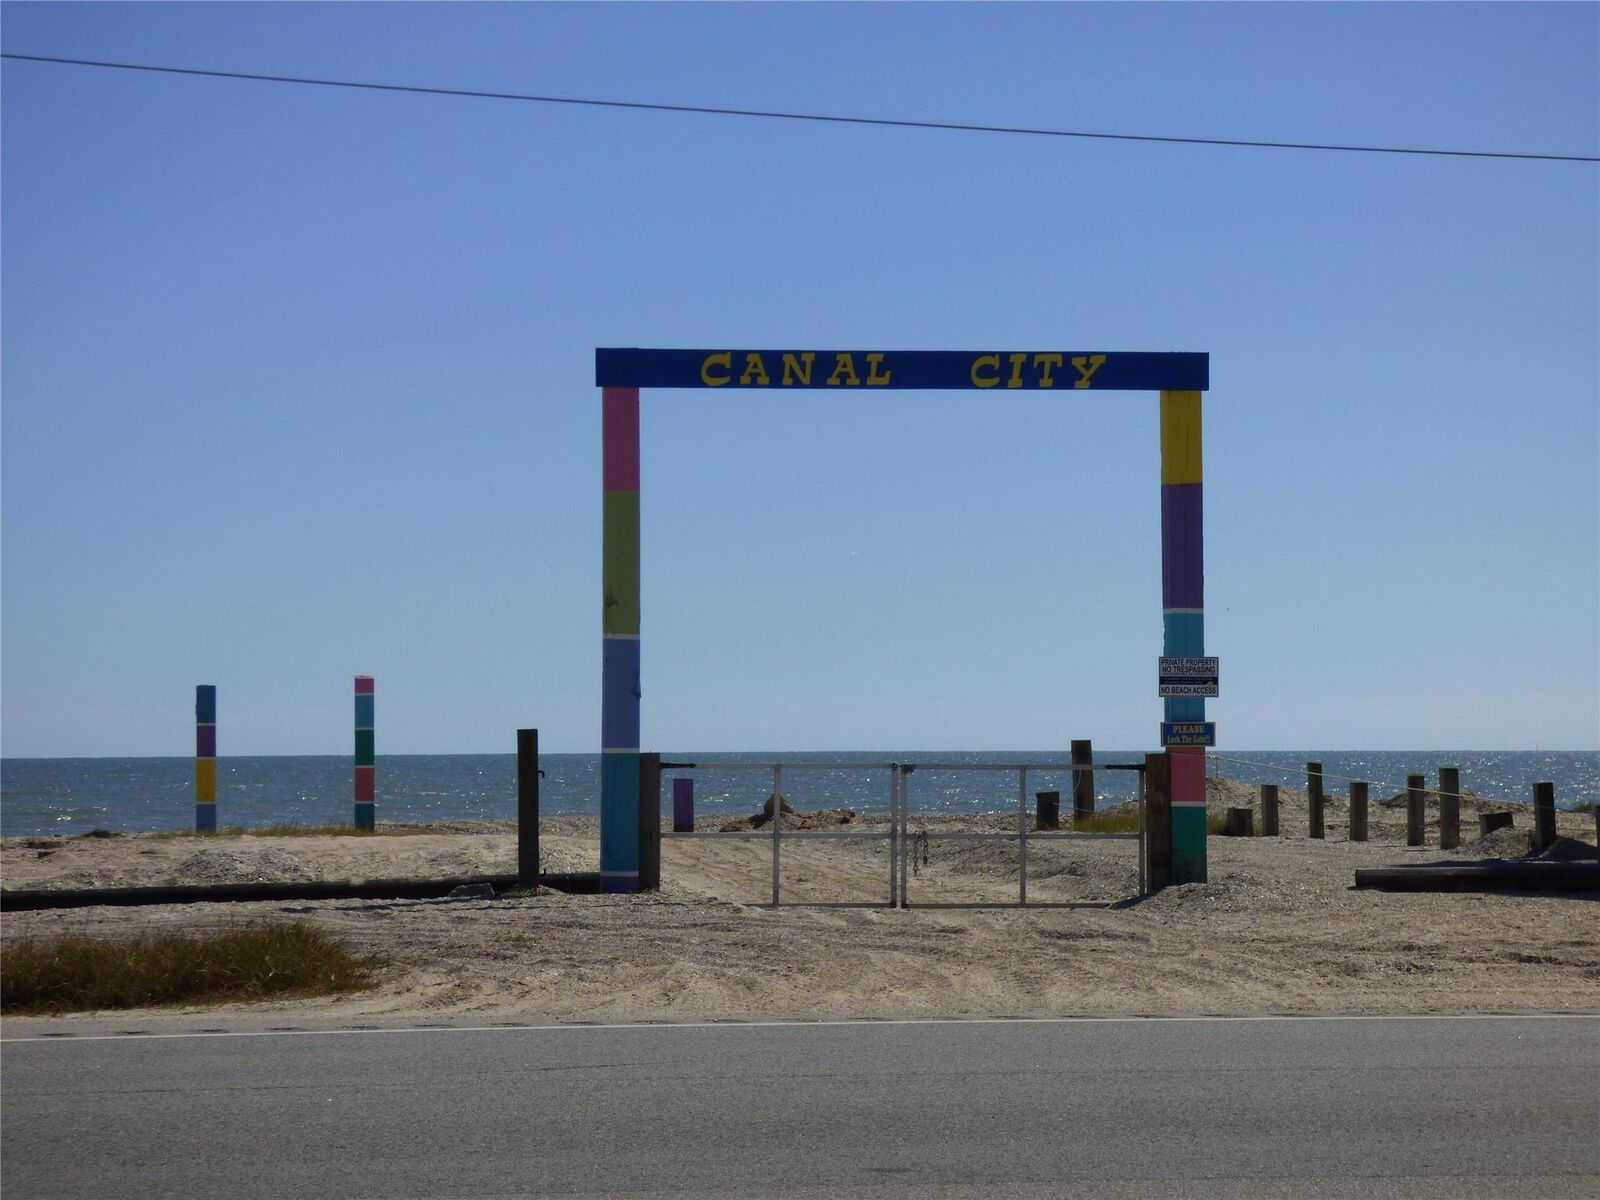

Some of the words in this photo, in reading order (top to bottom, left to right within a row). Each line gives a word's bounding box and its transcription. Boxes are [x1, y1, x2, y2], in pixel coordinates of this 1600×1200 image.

[700, 352, 892, 387] CANAL
[970, 353, 1107, 389] CITY
[1161, 658, 1185, 666] PRIVATE
[1185, 658, 1216, 666] PROPERTY
[1162, 665, 1172, 673] NO
[1173, 665, 1216, 673] TRESPASSING
[1161, 686, 1171, 694] NO
[1171, 686, 1192, 694] BEACH
[1193, 686, 1217, 694] ACCESS
[1173, 725, 1205, 733] PLEASE
[1167, 735, 1180, 744] Lock
[1181, 735, 1192, 743] The
